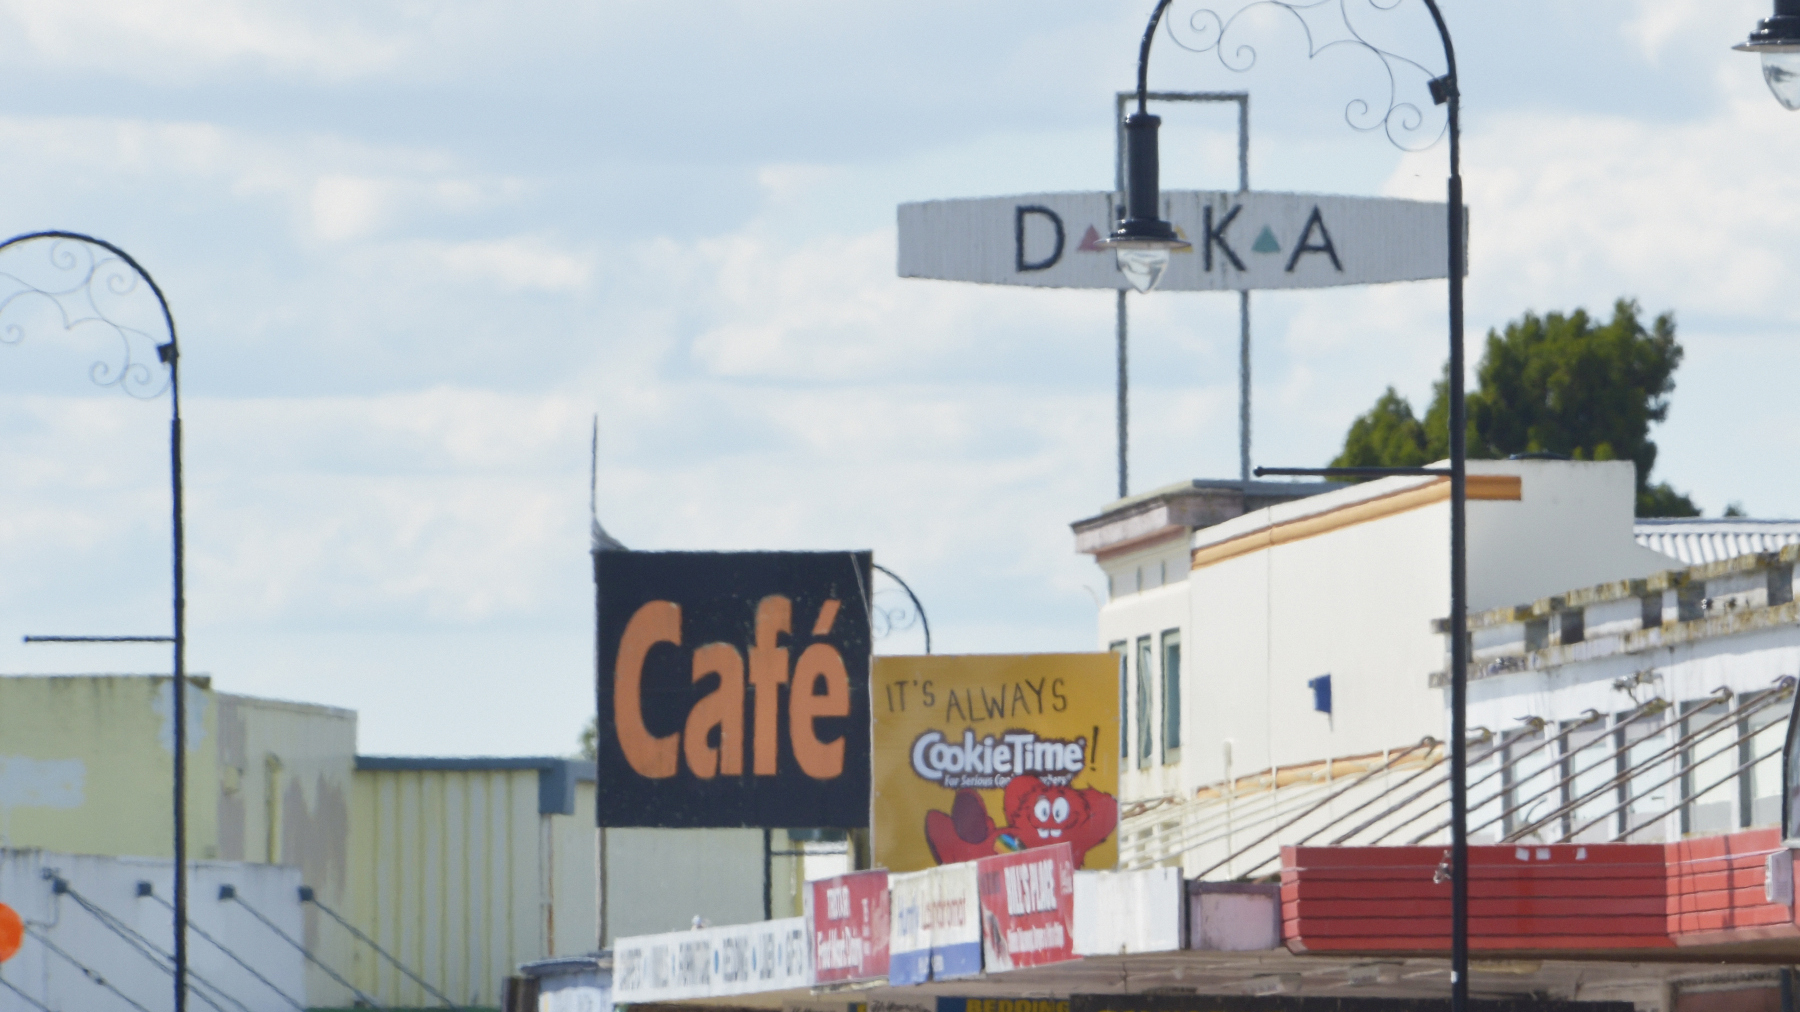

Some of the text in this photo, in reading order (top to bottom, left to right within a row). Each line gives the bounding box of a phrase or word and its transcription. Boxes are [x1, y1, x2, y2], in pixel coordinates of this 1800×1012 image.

[1014, 204, 1344, 273] DKA
[612, 594, 850, 781] Café
[885, 677, 1068, 723] IT'S ALWAYS
[961, 773, 993, 787] Serious
